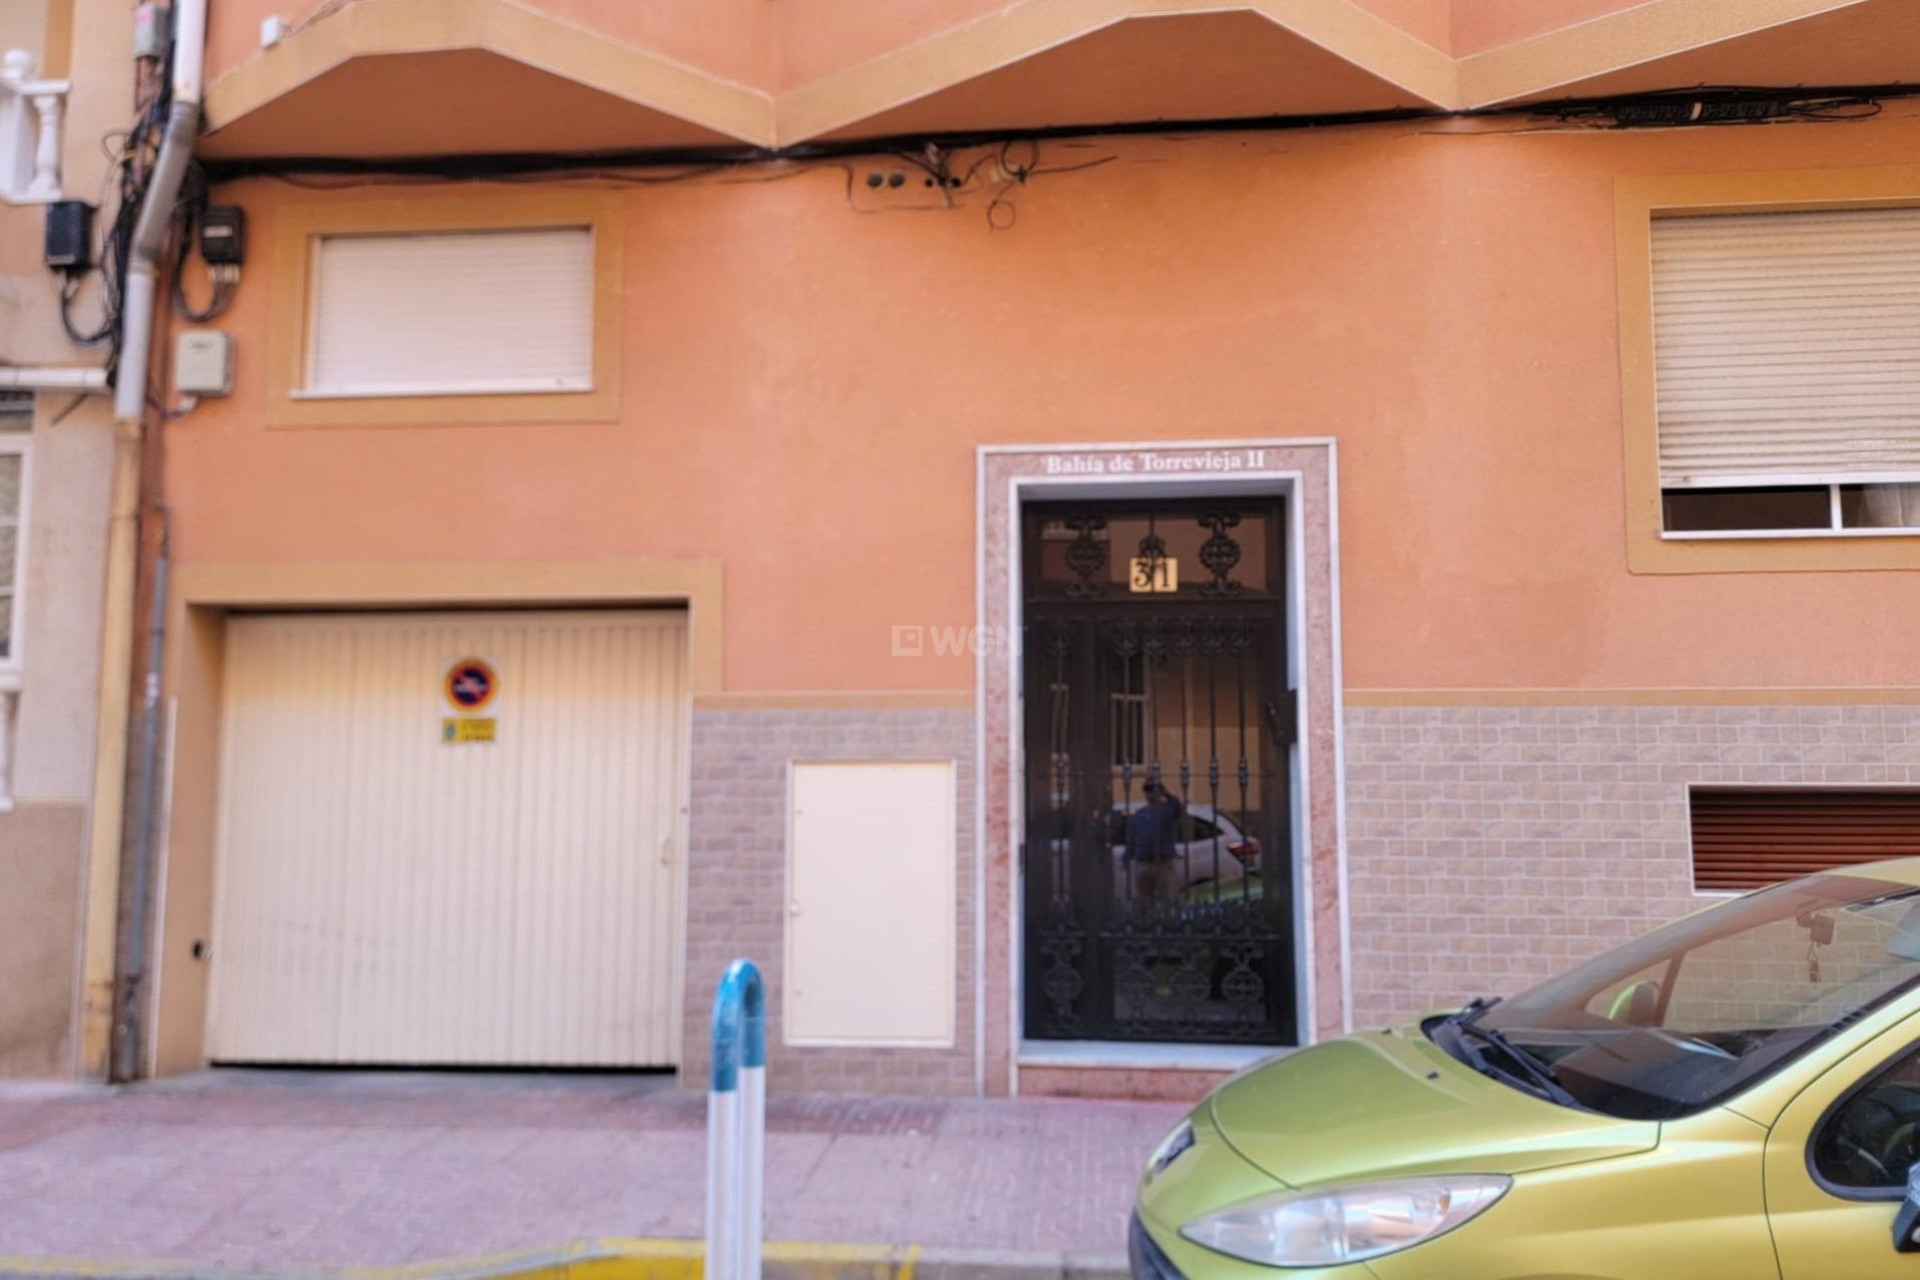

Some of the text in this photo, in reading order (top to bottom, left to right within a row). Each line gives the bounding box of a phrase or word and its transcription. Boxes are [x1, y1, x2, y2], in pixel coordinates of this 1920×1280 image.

[1046, 449, 1265, 473] Bahía de Torrevieja II
[1134, 561, 1169, 588] 31
